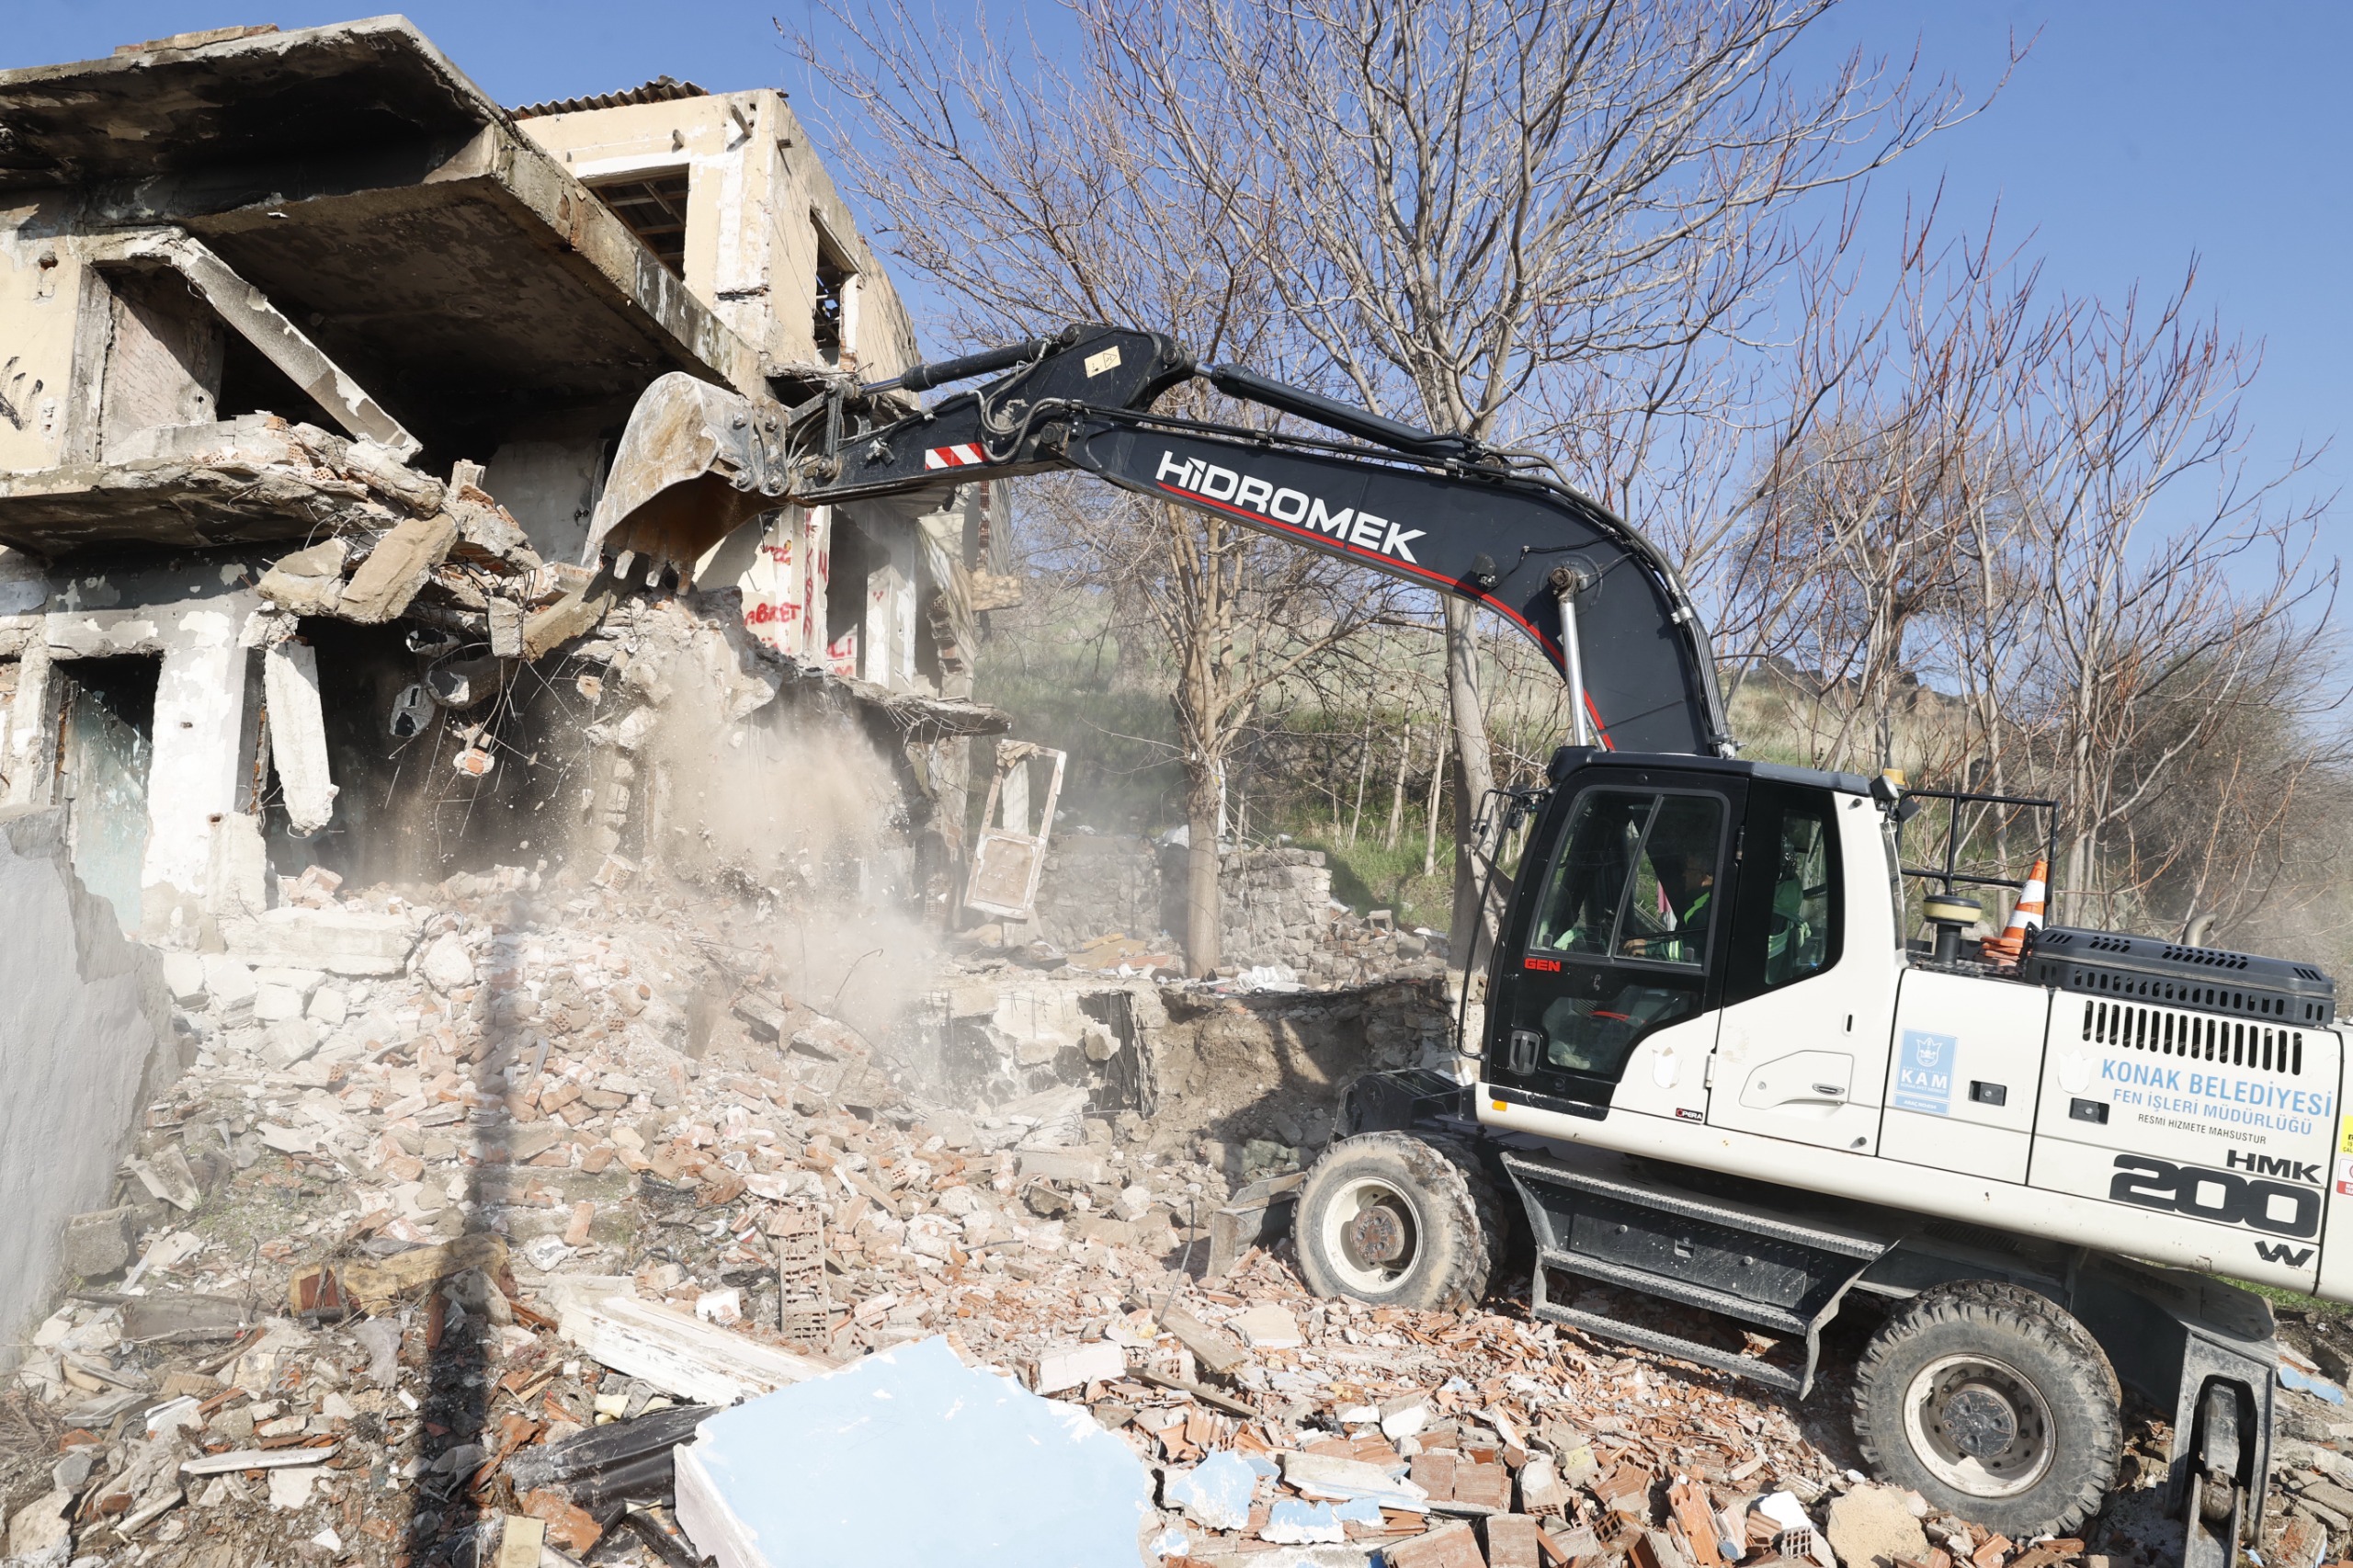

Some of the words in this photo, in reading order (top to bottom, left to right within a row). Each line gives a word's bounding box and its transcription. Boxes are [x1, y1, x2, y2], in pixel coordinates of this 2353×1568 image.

[1524, 958, 1561, 972] GEN
[1901, 1068, 1949, 1089] KAM
[2101, 1059, 2182, 1091] KONAK
[2188, 1074, 2333, 1118] BELEDİYESİ
[1677, 1108, 1702, 1119] OPERA
[2113, 1088, 2143, 1105] FEN
[2147, 1091, 2199, 1114] İŞLERİ
[2203, 1102, 2313, 1135] MÜDÜRLÜĞÜ
[2138, 1113, 2166, 1126] RESMİ
[2168, 1119, 2206, 1133] HİZMETE
[2209, 1126, 2267, 1144] MAHSUSTUR
[2226, 1150, 2322, 1184] HMK
[2109, 1153, 2321, 1238] 200
[2255, 1241, 2315, 1267] W
